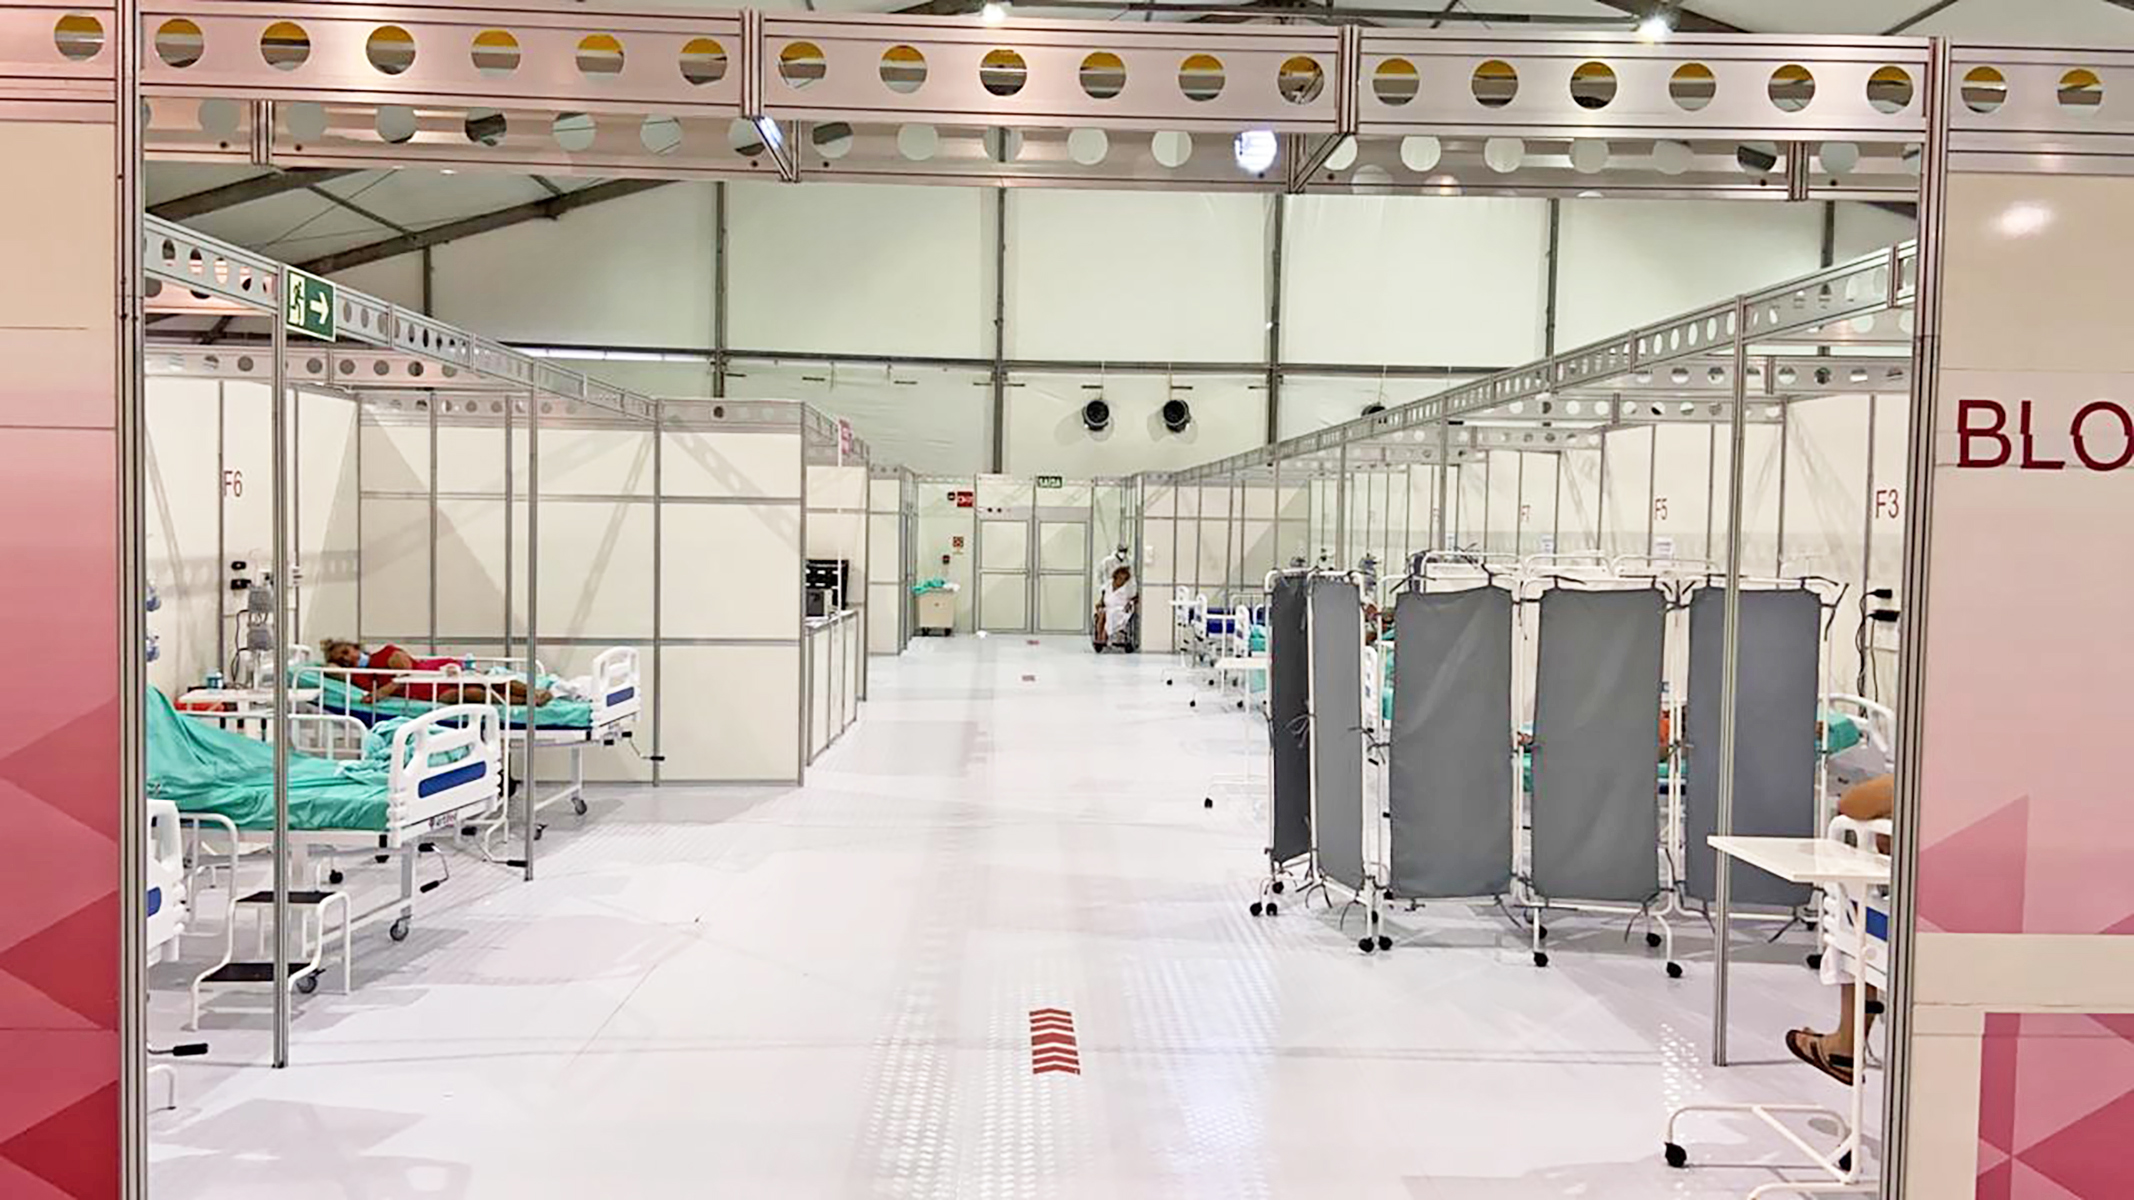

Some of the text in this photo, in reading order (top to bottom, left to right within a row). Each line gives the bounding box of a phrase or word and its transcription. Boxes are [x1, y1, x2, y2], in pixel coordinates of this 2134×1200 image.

[1957, 399, 2134, 471] BLO
[223, 470, 242, 497] F6
[1654, 498, 1668, 520] F5
[1876, 489, 1899, 518] F3
